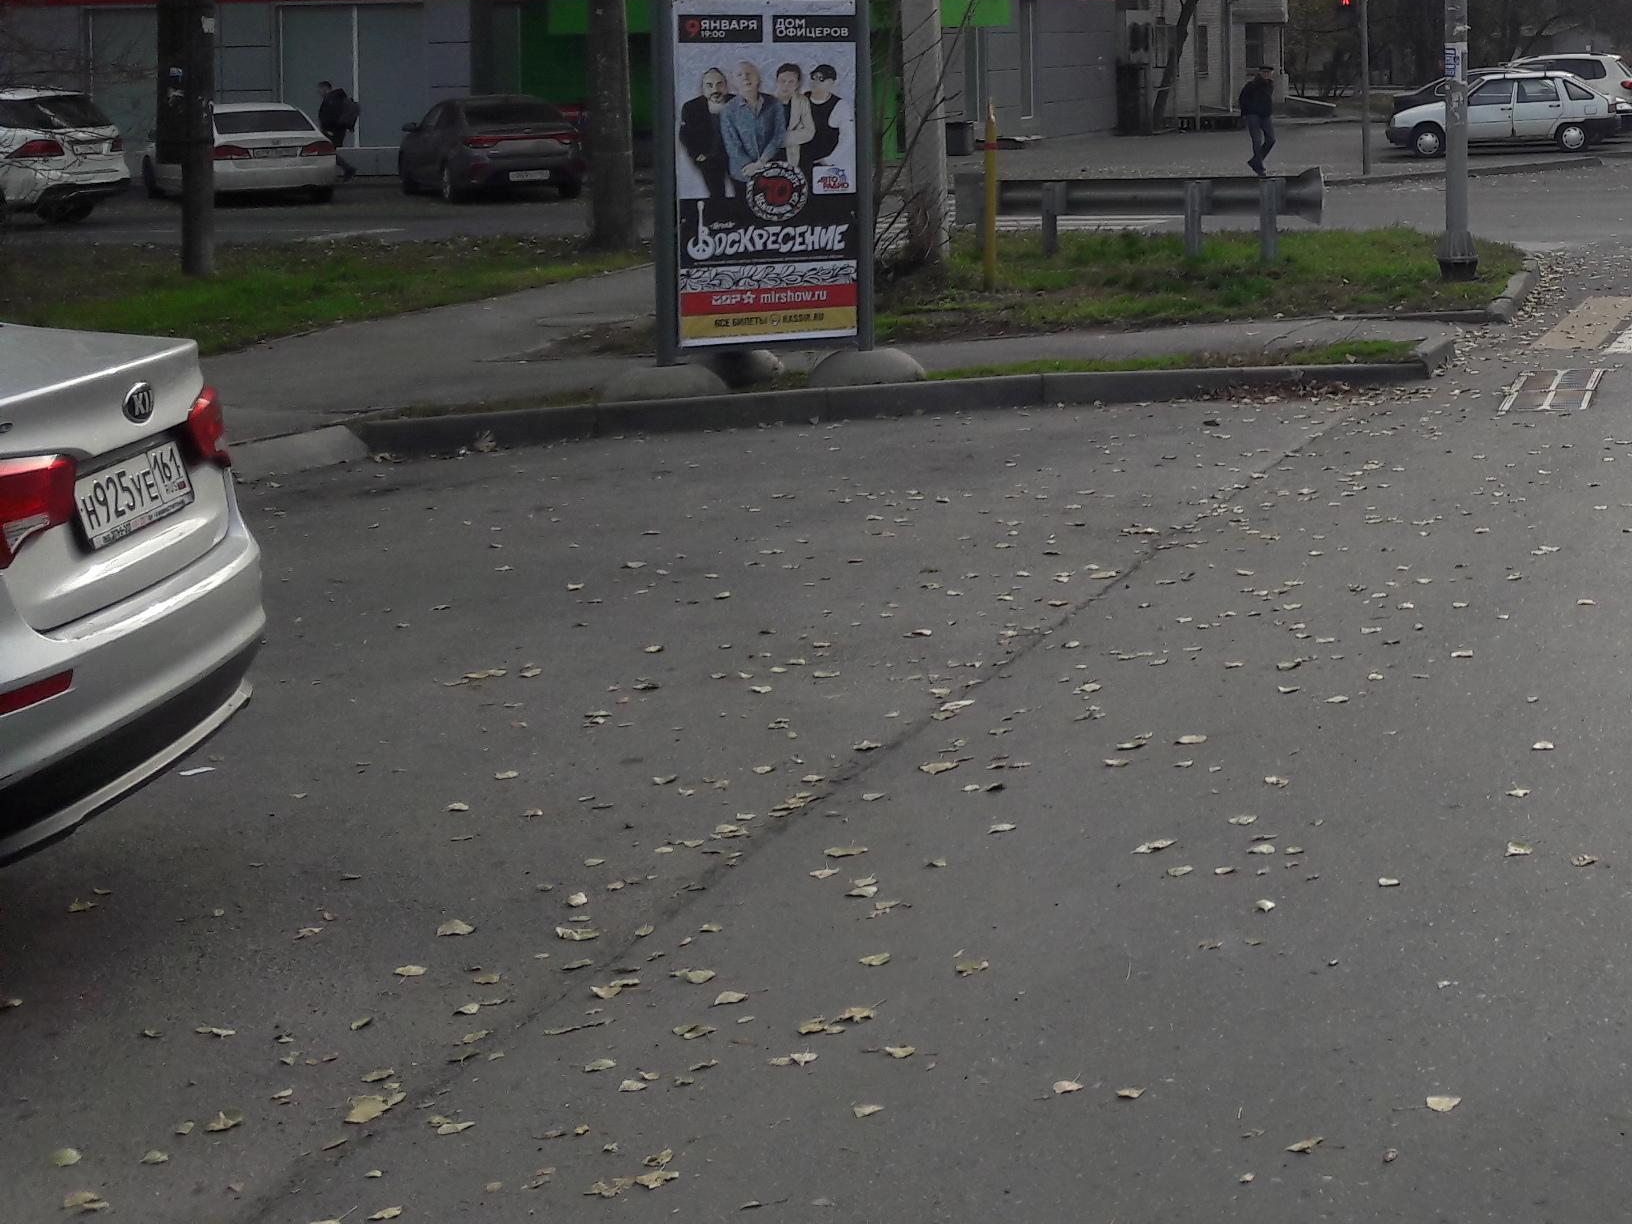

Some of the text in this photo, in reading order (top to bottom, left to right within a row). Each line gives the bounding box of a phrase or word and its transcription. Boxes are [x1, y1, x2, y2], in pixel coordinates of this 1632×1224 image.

[686, 18, 758, 38] 9 ЯНВАРЯ
[775, 17, 806, 28] ДОМ
[701, 30, 726, 38] 19:00
[776, 27, 849, 38] ОФИЦЕРОВ
[760, 290, 828, 304] mirshow.ru
[132, 389, 153, 417] KI
[81, 468, 159, 530] Н925УЕ
[151, 446, 184, 484] 161
